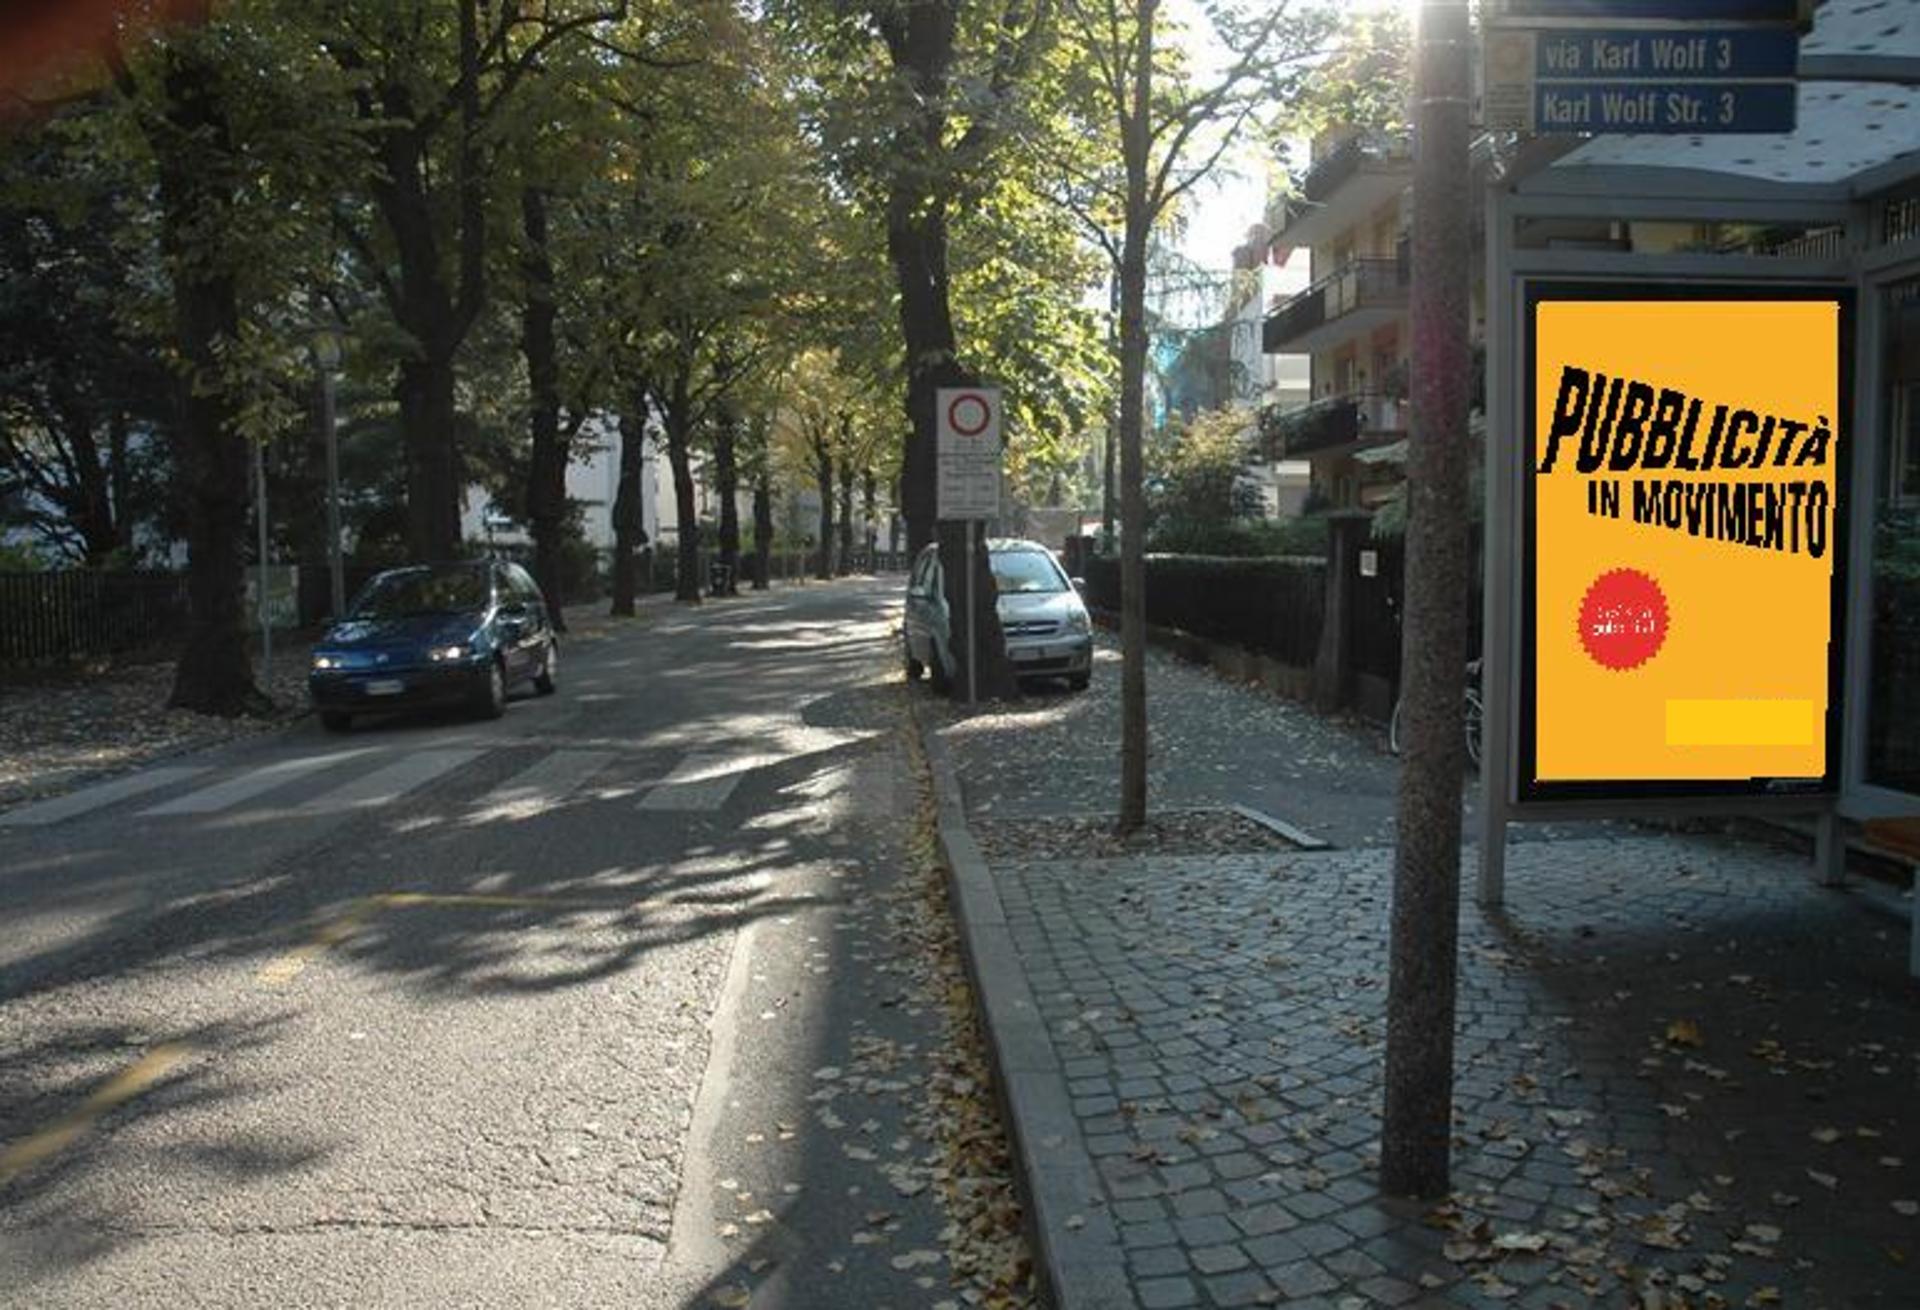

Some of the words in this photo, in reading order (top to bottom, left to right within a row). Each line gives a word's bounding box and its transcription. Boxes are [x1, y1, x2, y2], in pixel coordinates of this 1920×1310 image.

[1546, 38, 1580, 69] via
[1593, 39, 1639, 69] Karl
[1651, 38, 1706, 69] Wolf
[1716, 39, 1732, 69] 3
[1543, 93, 1590, 124] Karl
[1602, 93, 1656, 124] Wolf
[1667, 93, 1707, 124] Str.
[1719, 93, 1735, 124] 3
[1537, 365, 1831, 474] PUBBLICITÀ
[1588, 480, 1620, 519] IN
[1633, 480, 1829, 559] MOVIMENTO
